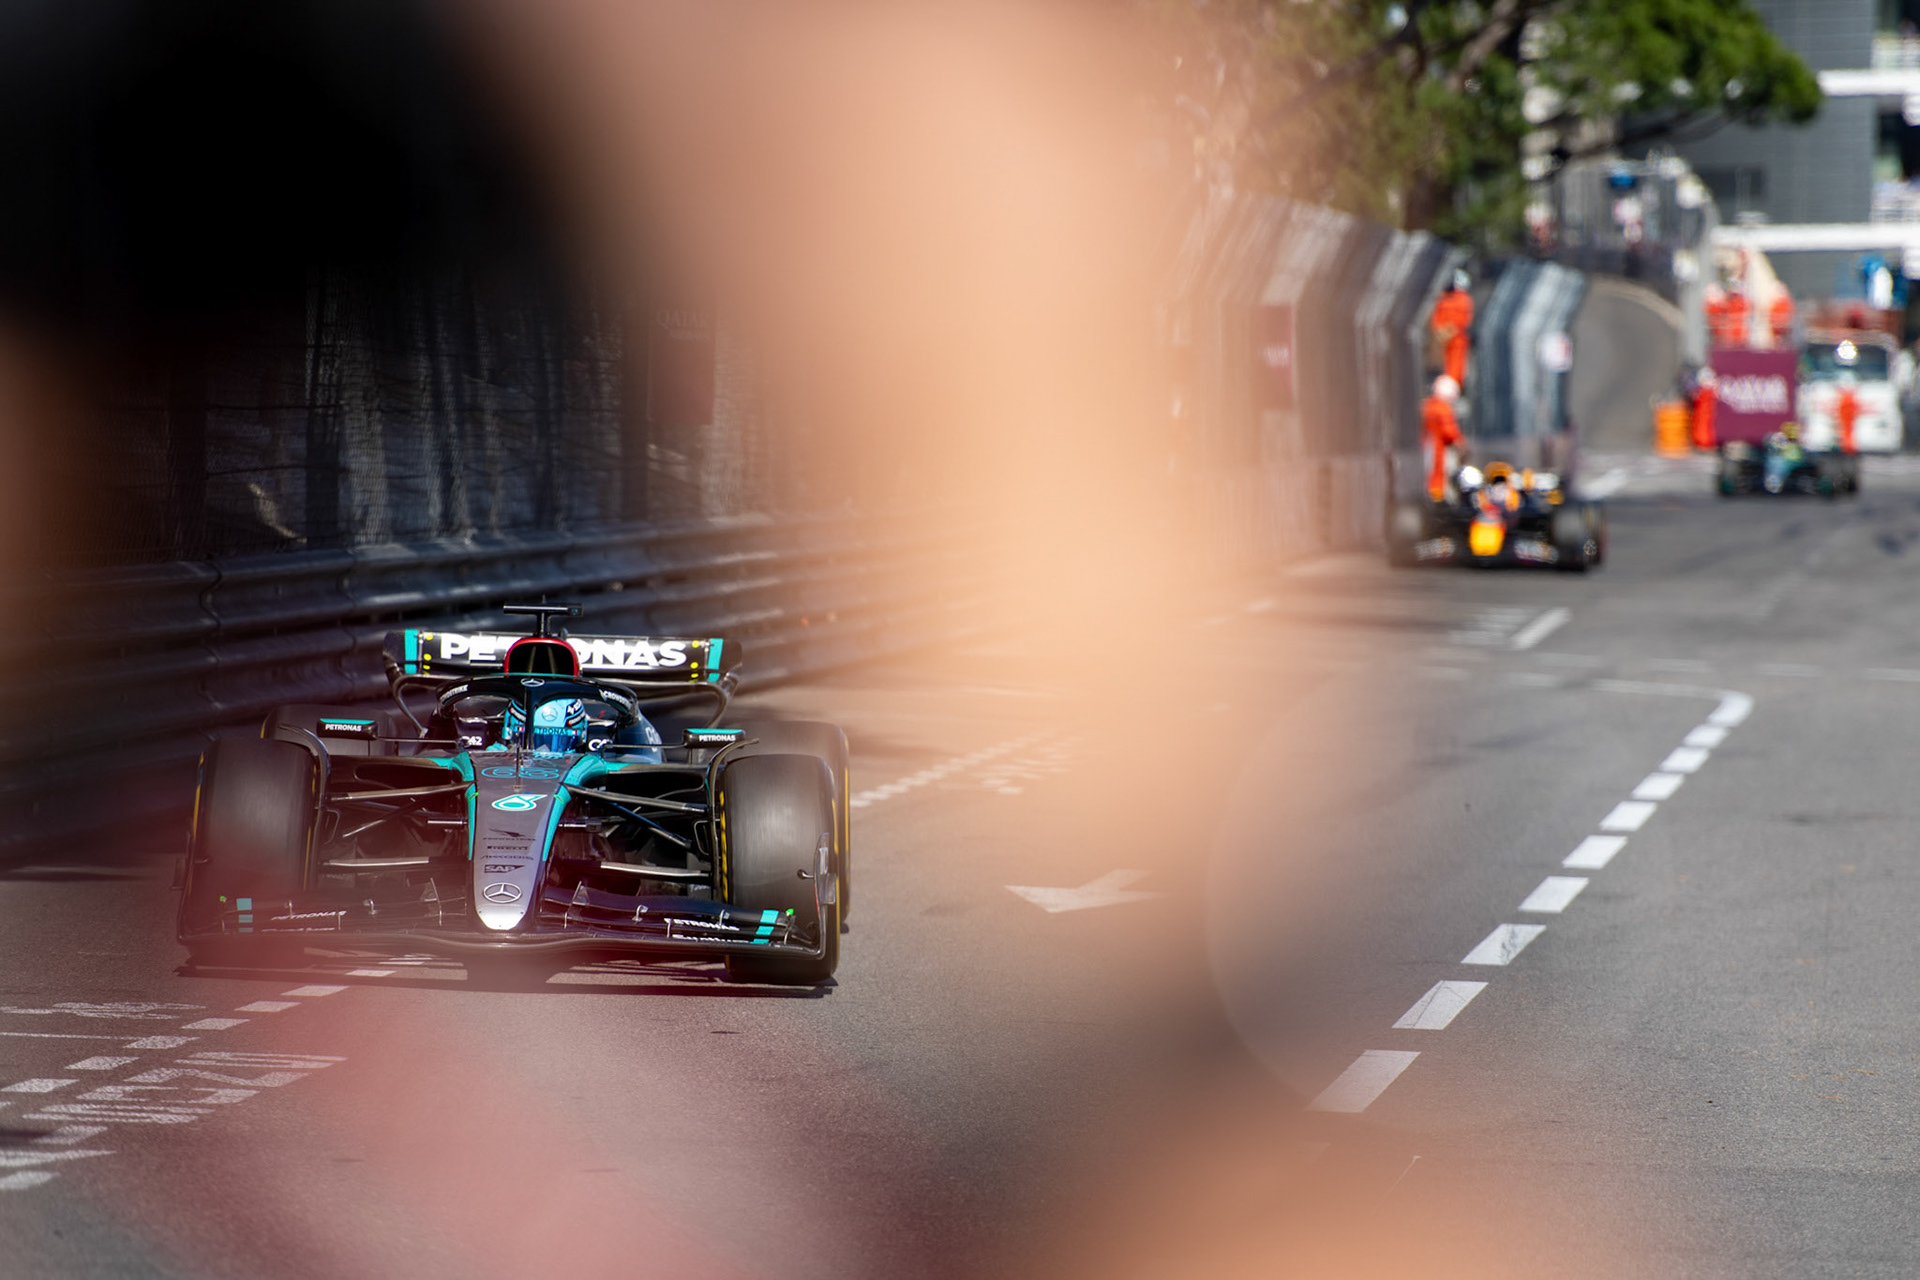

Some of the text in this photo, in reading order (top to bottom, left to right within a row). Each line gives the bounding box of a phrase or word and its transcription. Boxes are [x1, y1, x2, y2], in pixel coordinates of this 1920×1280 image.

[440, 633, 688, 667] PEONAS
[325, 723, 362, 732] PETRONAS
[699, 734, 736, 742] PETRONAS
[663, 917, 740, 931] PETRONAS
